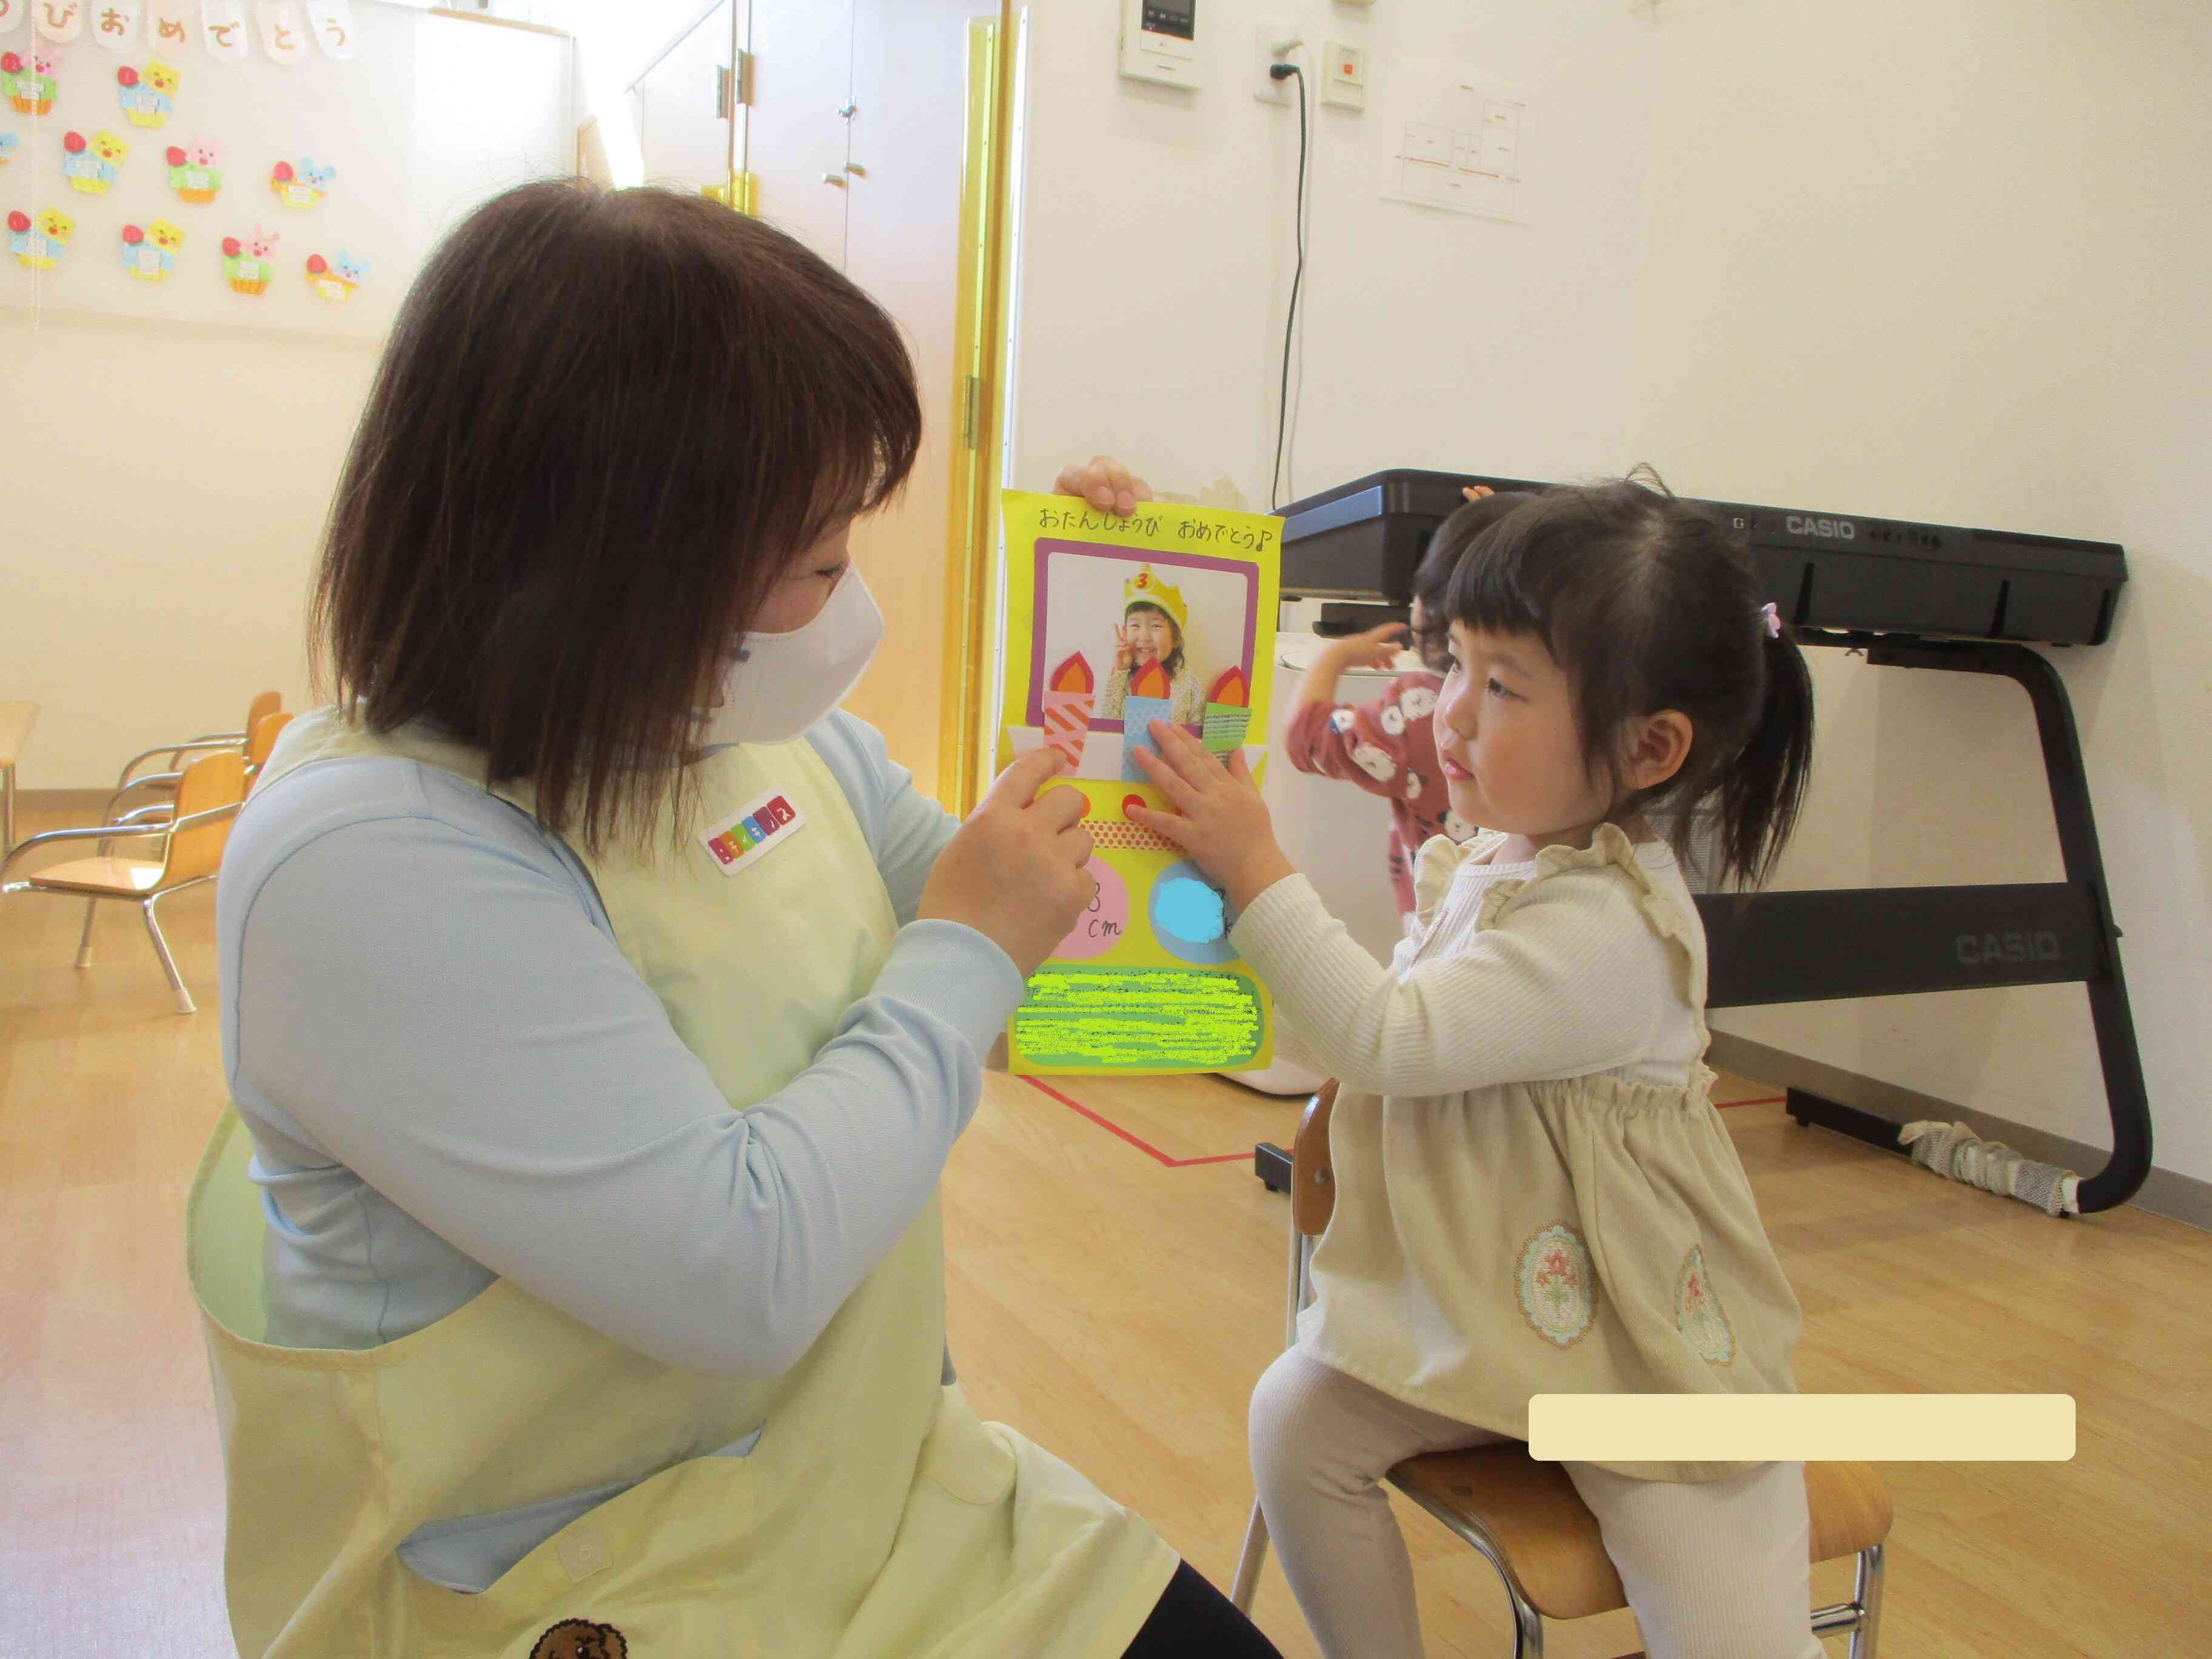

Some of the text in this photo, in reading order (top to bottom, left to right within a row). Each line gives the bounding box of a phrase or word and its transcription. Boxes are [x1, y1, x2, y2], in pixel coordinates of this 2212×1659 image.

[1786, 515, 1855, 539] CASIO
[1138, 572, 1148, 588] 3
[1956, 931, 2060, 964] CASIO
